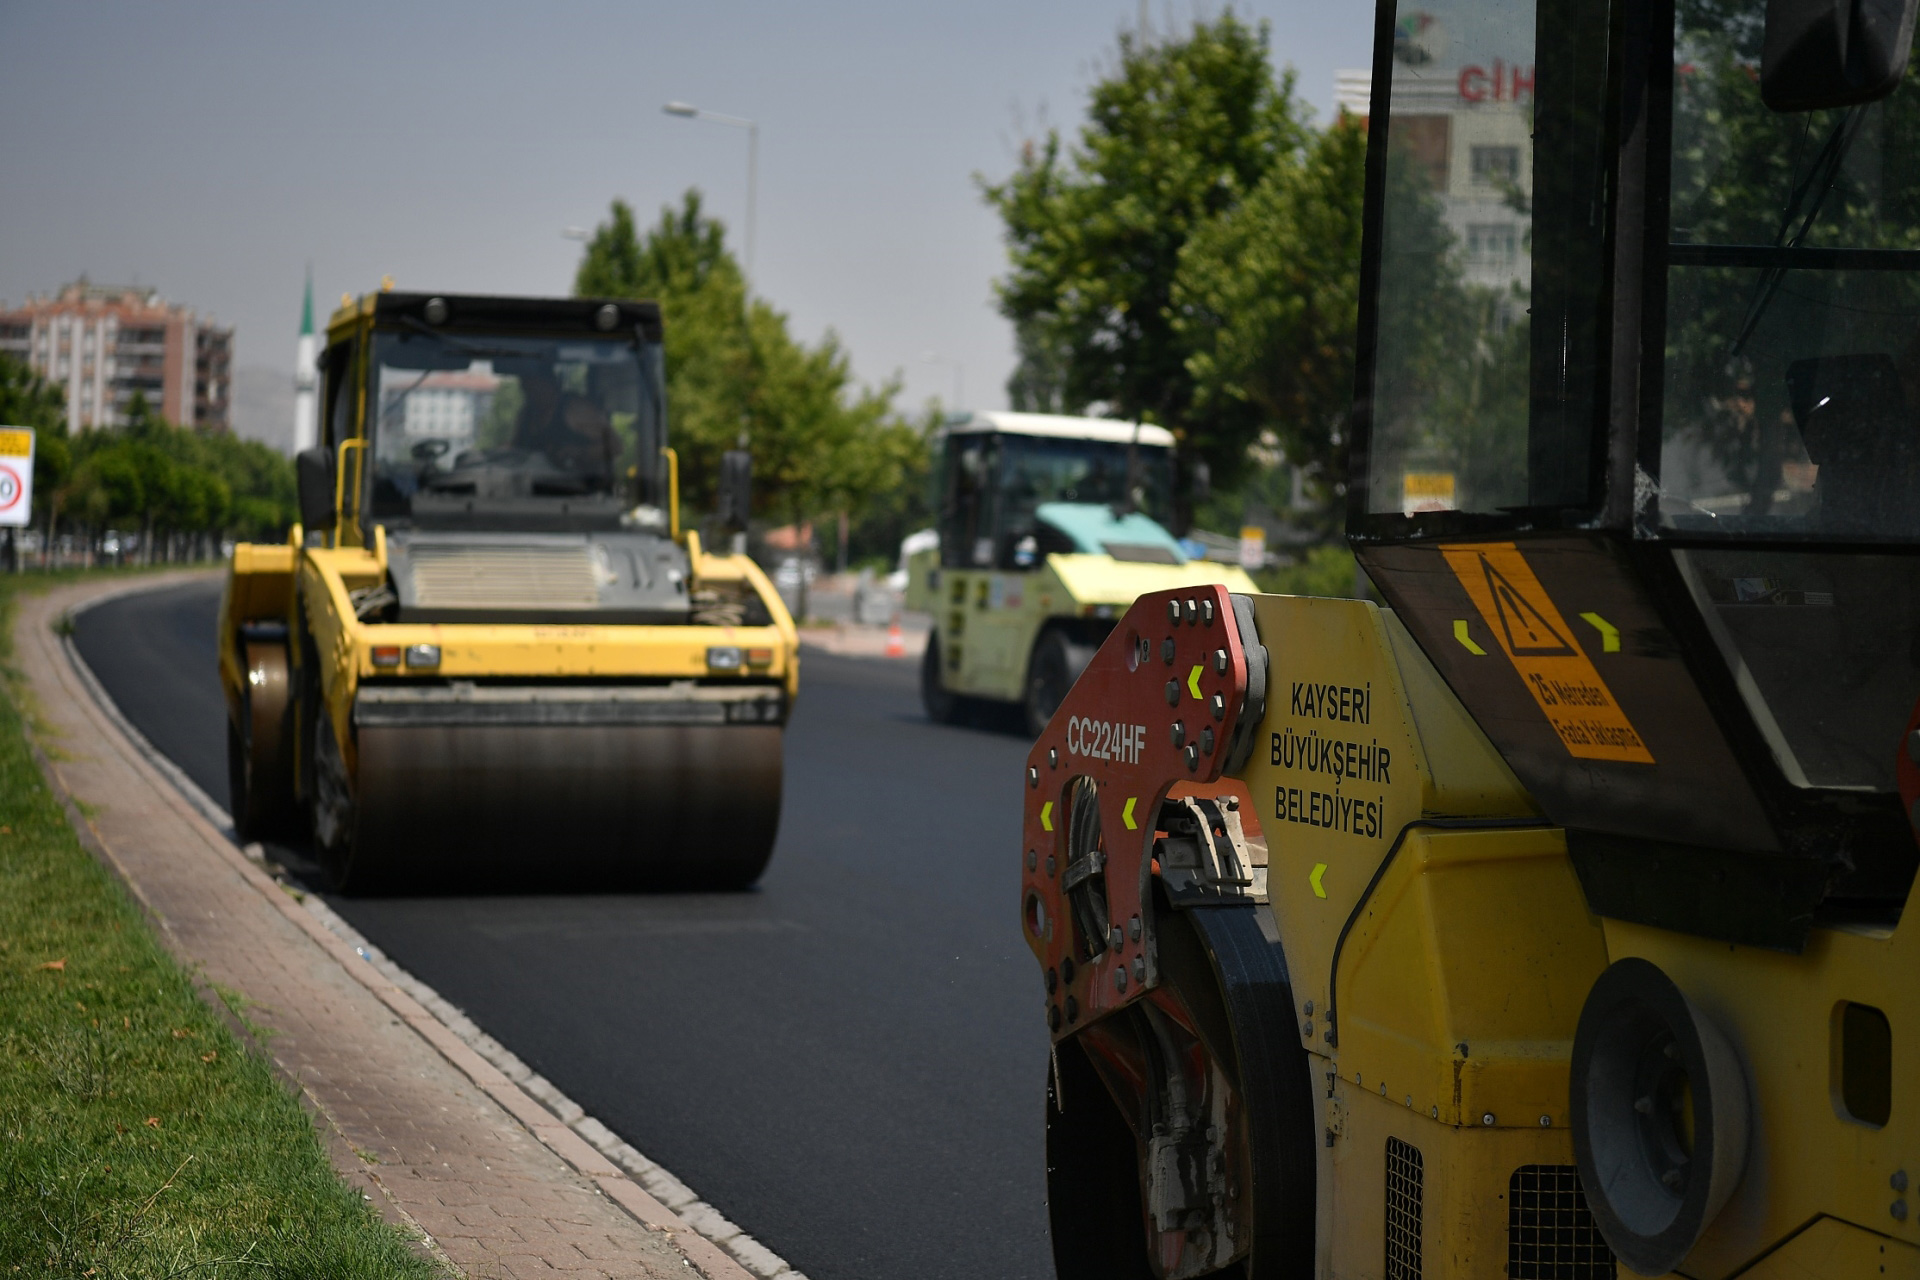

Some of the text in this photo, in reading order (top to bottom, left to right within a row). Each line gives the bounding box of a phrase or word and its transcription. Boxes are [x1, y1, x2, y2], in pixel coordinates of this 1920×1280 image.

[1291, 681, 1371, 725] KAYSERİ
[1528, 673, 1610, 707] 25 Metreden
[1067, 716, 1147, 765] CC224HF
[1553, 719, 1591, 745] Fazla
[1271, 732, 1392, 785] BÜYÜKŞEHİR
[1276, 786, 1383, 840] BELEDİYESİ
